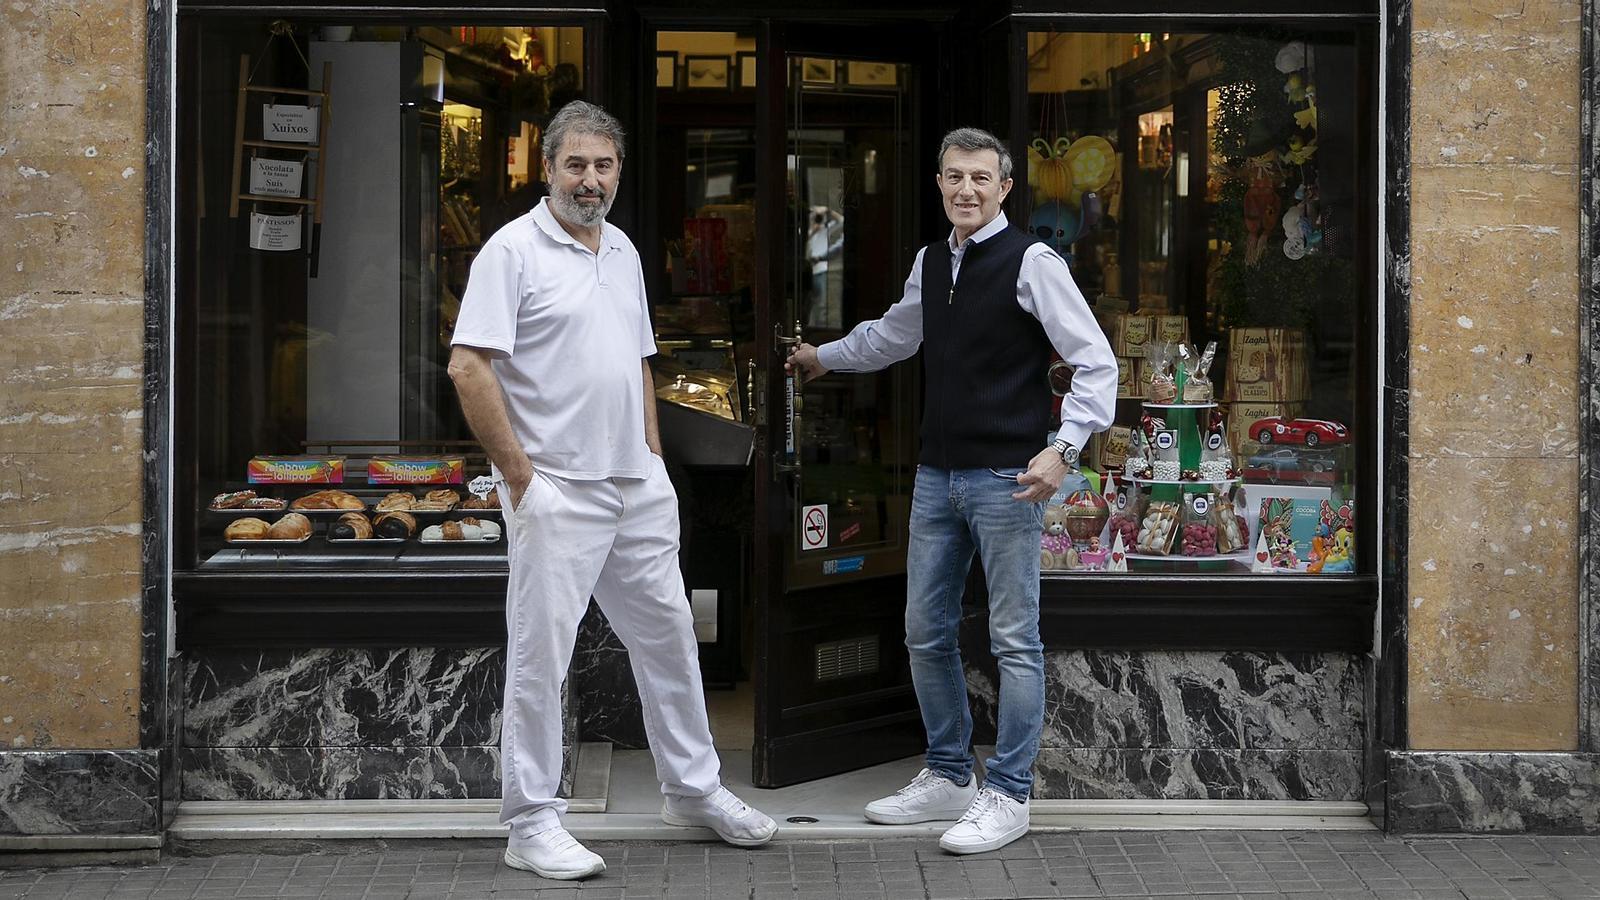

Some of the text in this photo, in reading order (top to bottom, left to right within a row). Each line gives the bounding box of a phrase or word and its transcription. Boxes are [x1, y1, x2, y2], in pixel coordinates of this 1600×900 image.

[272, 123, 309, 134] Xuixos
[259, 162, 294, 173] Xocolata
[264, 463, 308, 472] rainbow
[384, 463, 428, 472] rainbow
[273, 472, 312, 483] lollipop
[393, 472, 432, 483] lollipop
